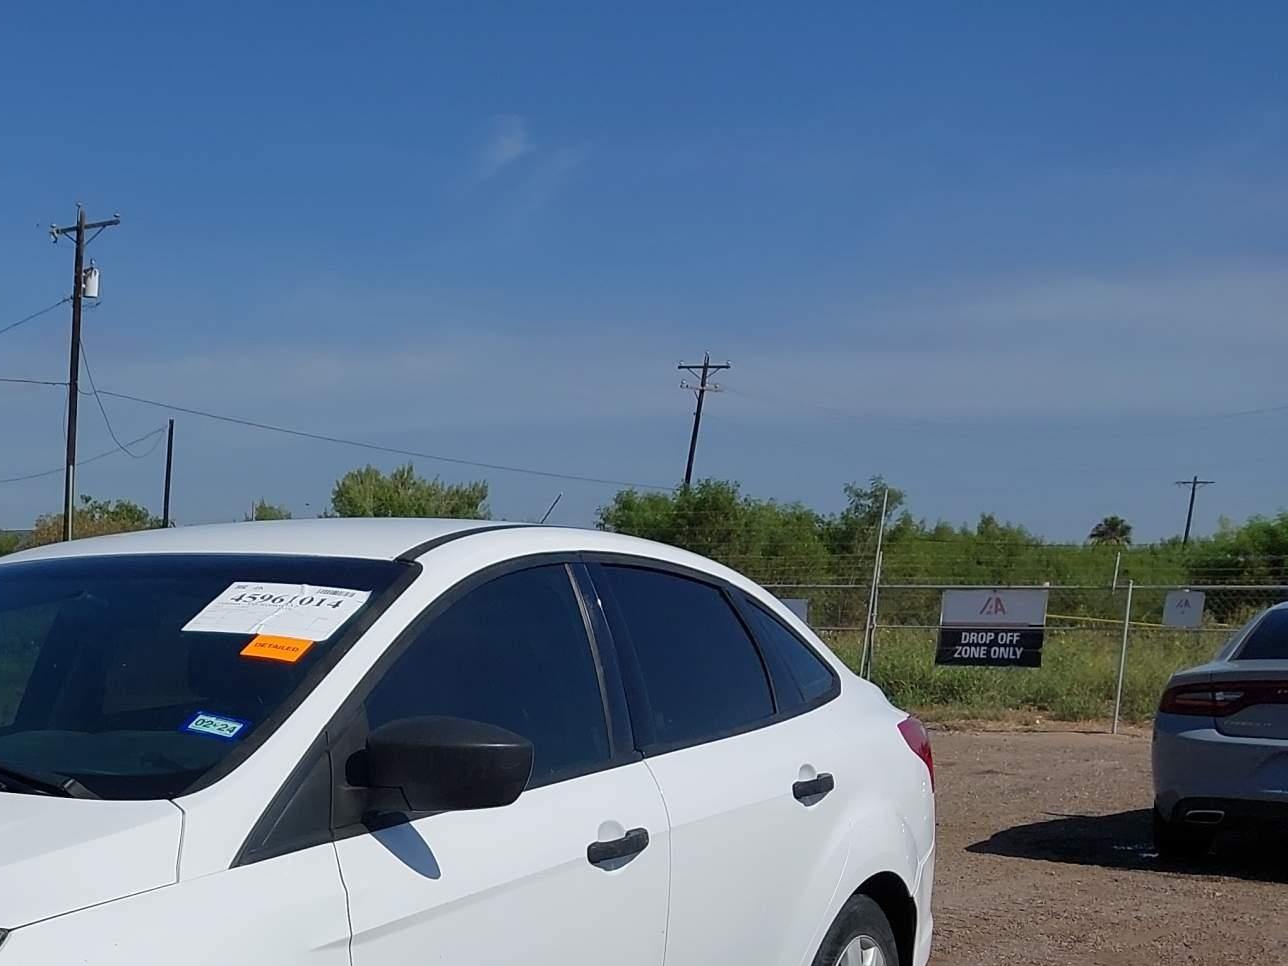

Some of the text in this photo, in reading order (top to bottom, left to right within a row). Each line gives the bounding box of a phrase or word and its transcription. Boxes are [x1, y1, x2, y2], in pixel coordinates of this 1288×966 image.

[230, 592, 344, 609] 45961014
[961, 632, 1021, 645] DROP OFF
[953, 645, 1024, 659] ZONE ONLY
